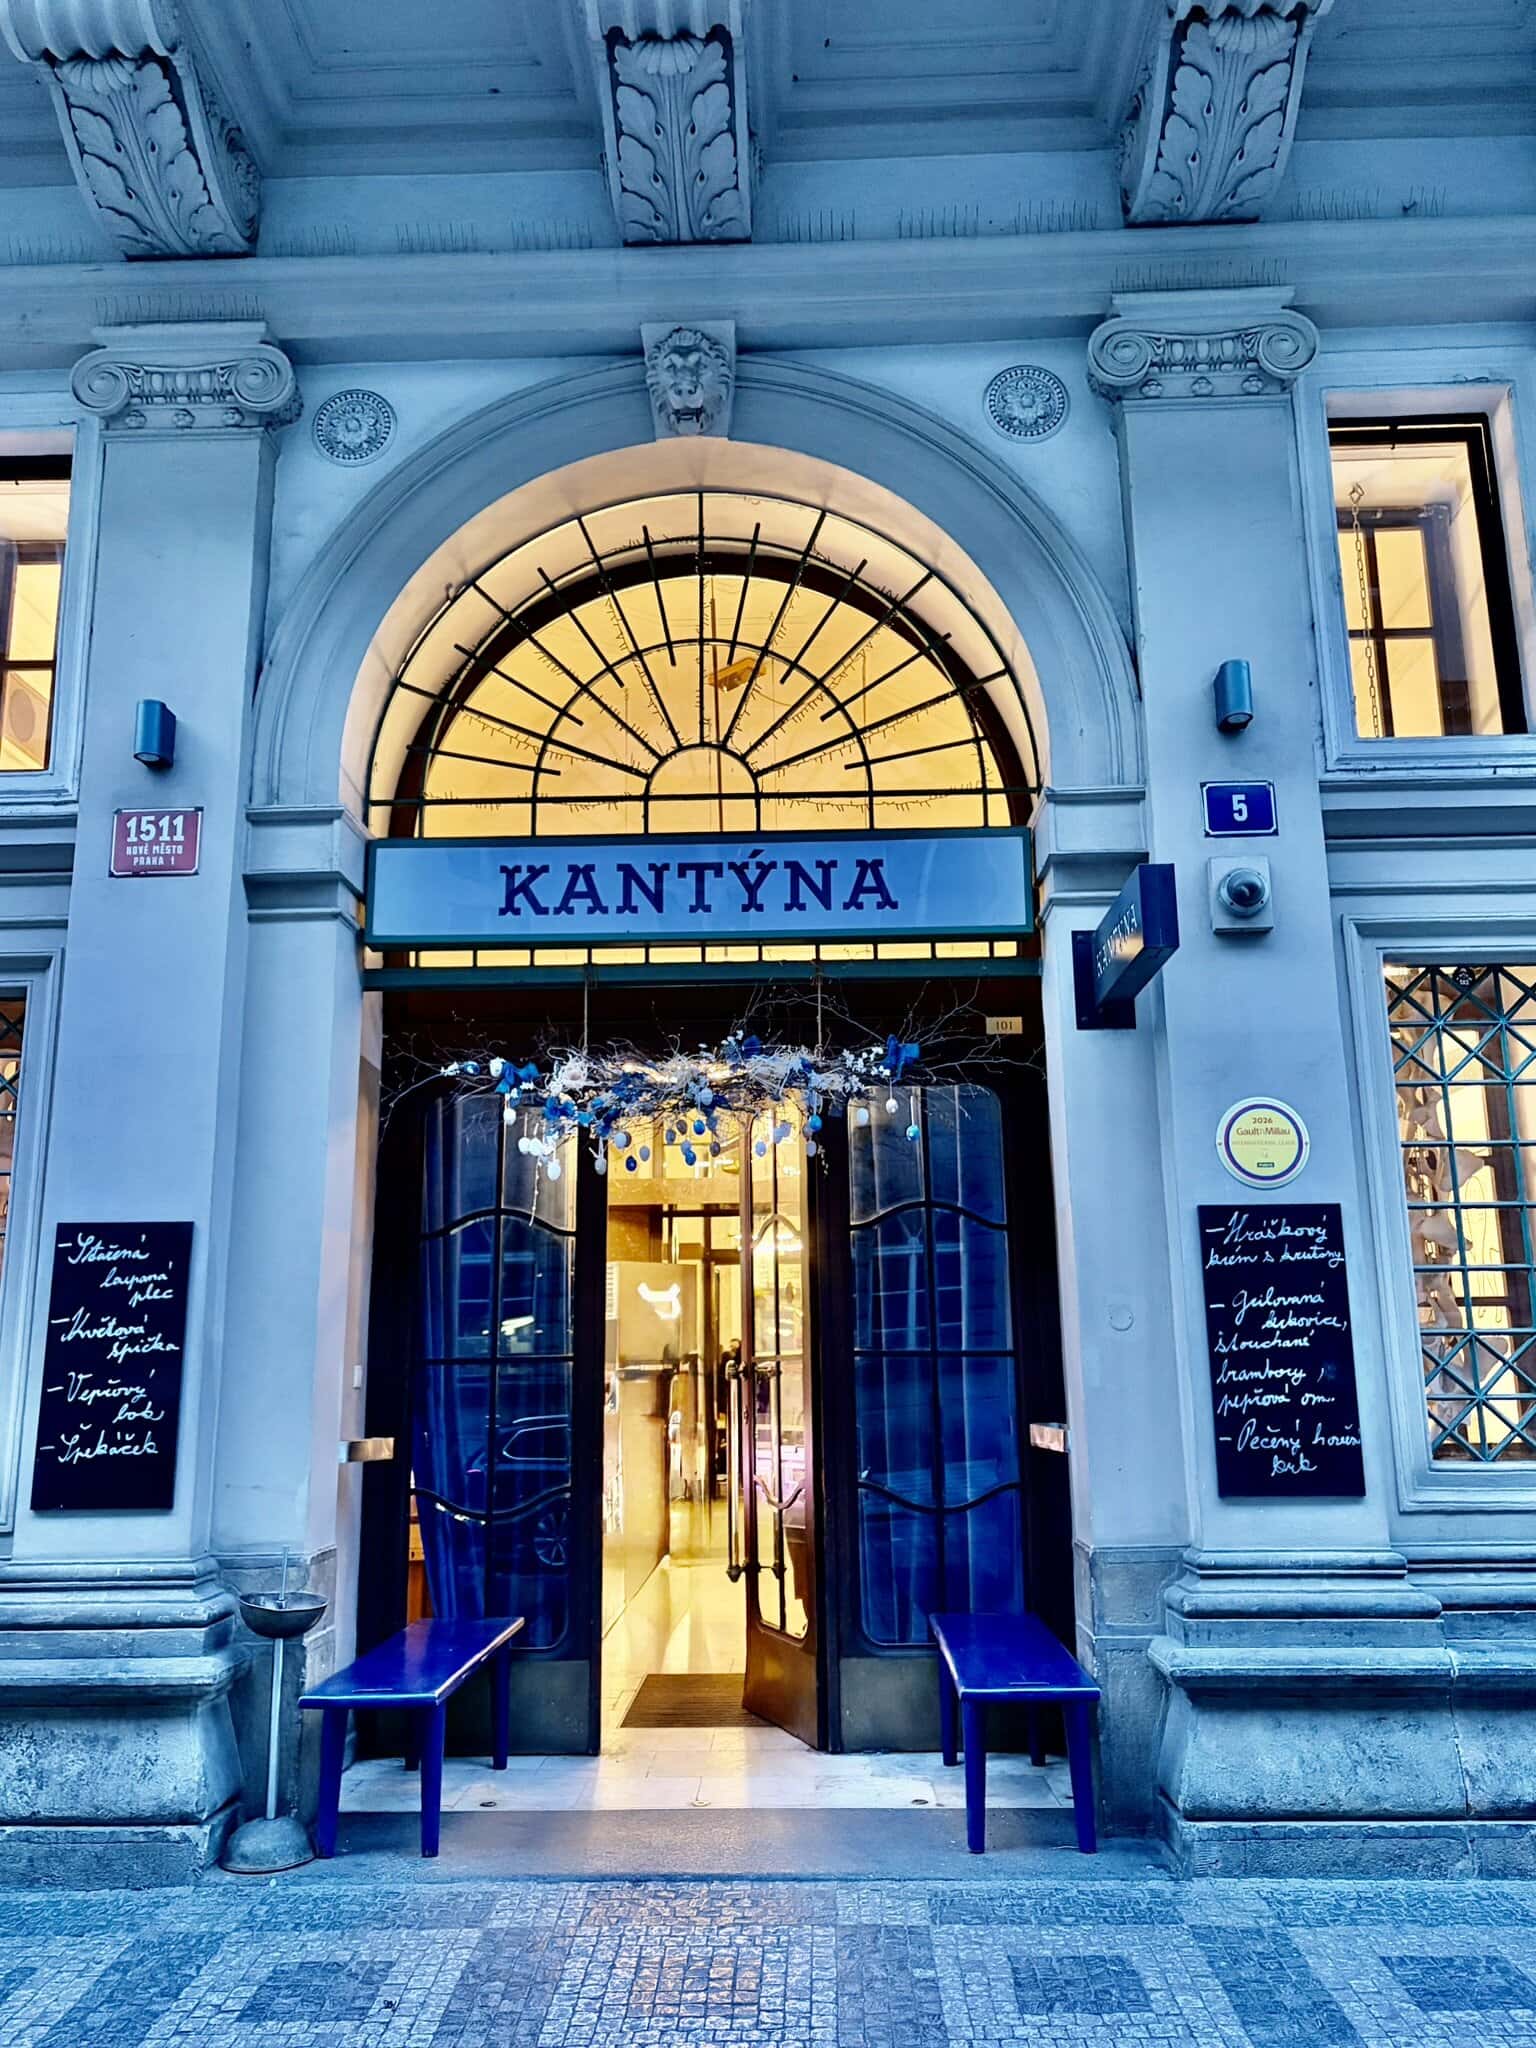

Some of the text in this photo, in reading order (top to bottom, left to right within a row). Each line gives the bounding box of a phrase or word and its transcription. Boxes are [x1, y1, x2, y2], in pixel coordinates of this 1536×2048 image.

[1232, 794, 1248, 822] 5
[126, 814, 185, 842] 1511
[126, 842, 184, 856] NOVÉ MĚSTO
[133, 855, 175, 866] PRAHA 1
[499, 849, 899, 916] KANTÝNA
[996, 1021, 1014, 1031] 101
[1223, 1211, 1328, 1243] Hráškový
[1204, 1243, 1345, 1270] krém s krutony
[127, 1283, 175, 1308] plec
[60, 1306, 149, 1343] Květová
[105, 1333, 181, 1365] špička
[67, 1368, 157, 1406] Vepřový
[1216, 1383, 1292, 1417] pepřová
[111, 1400, 166, 1424] bok
[57, 1423, 159, 1465] Špekáček
[1236, 1418, 1302, 1456] Pečený
[1270, 1452, 1319, 1477] krk
